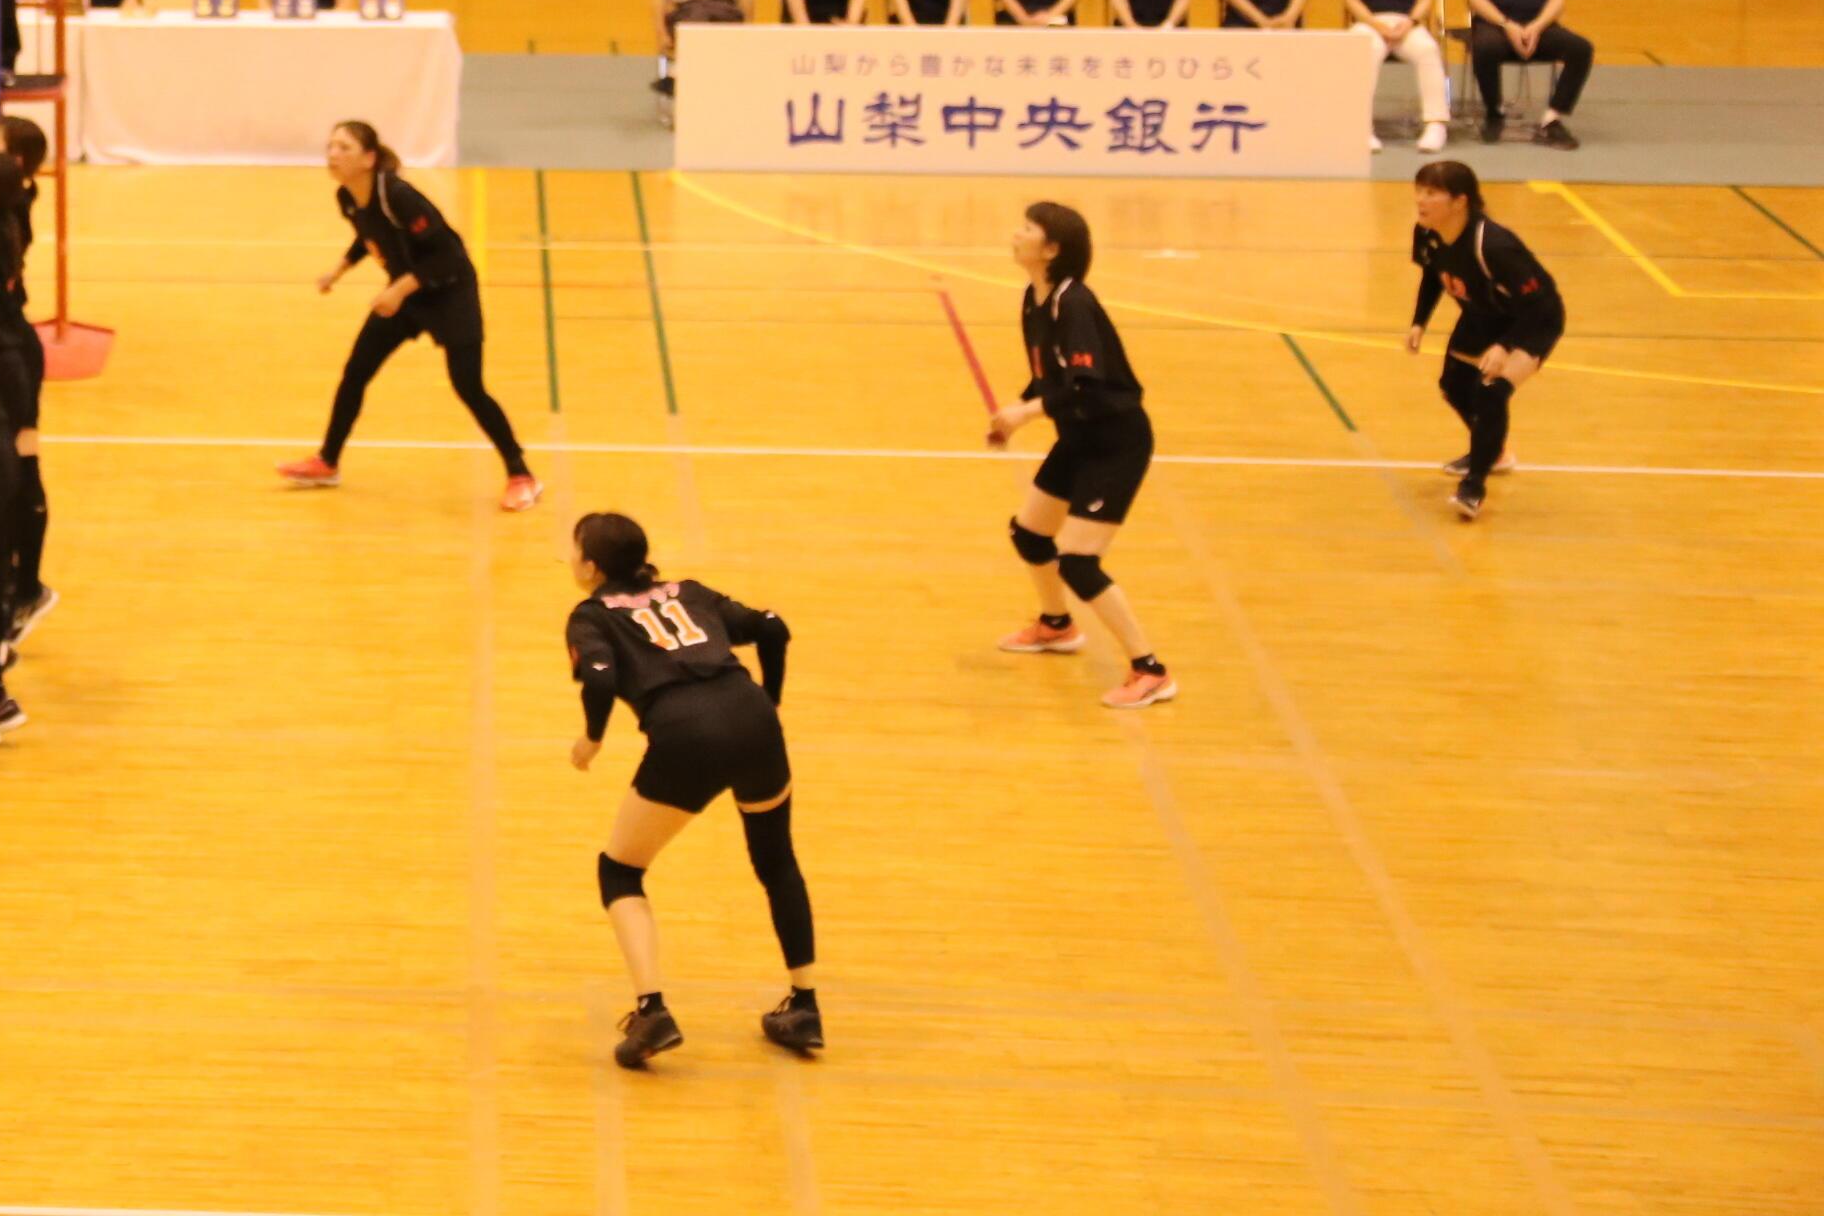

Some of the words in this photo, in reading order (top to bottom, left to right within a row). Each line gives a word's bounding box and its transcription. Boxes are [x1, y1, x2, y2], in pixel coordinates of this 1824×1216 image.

[789, 53, 1264, 80] 山梨から豊かな未来をきりひらく
[785, 91, 1270, 155] 山梨中央銀行
[632, 598, 709, 652] 11
